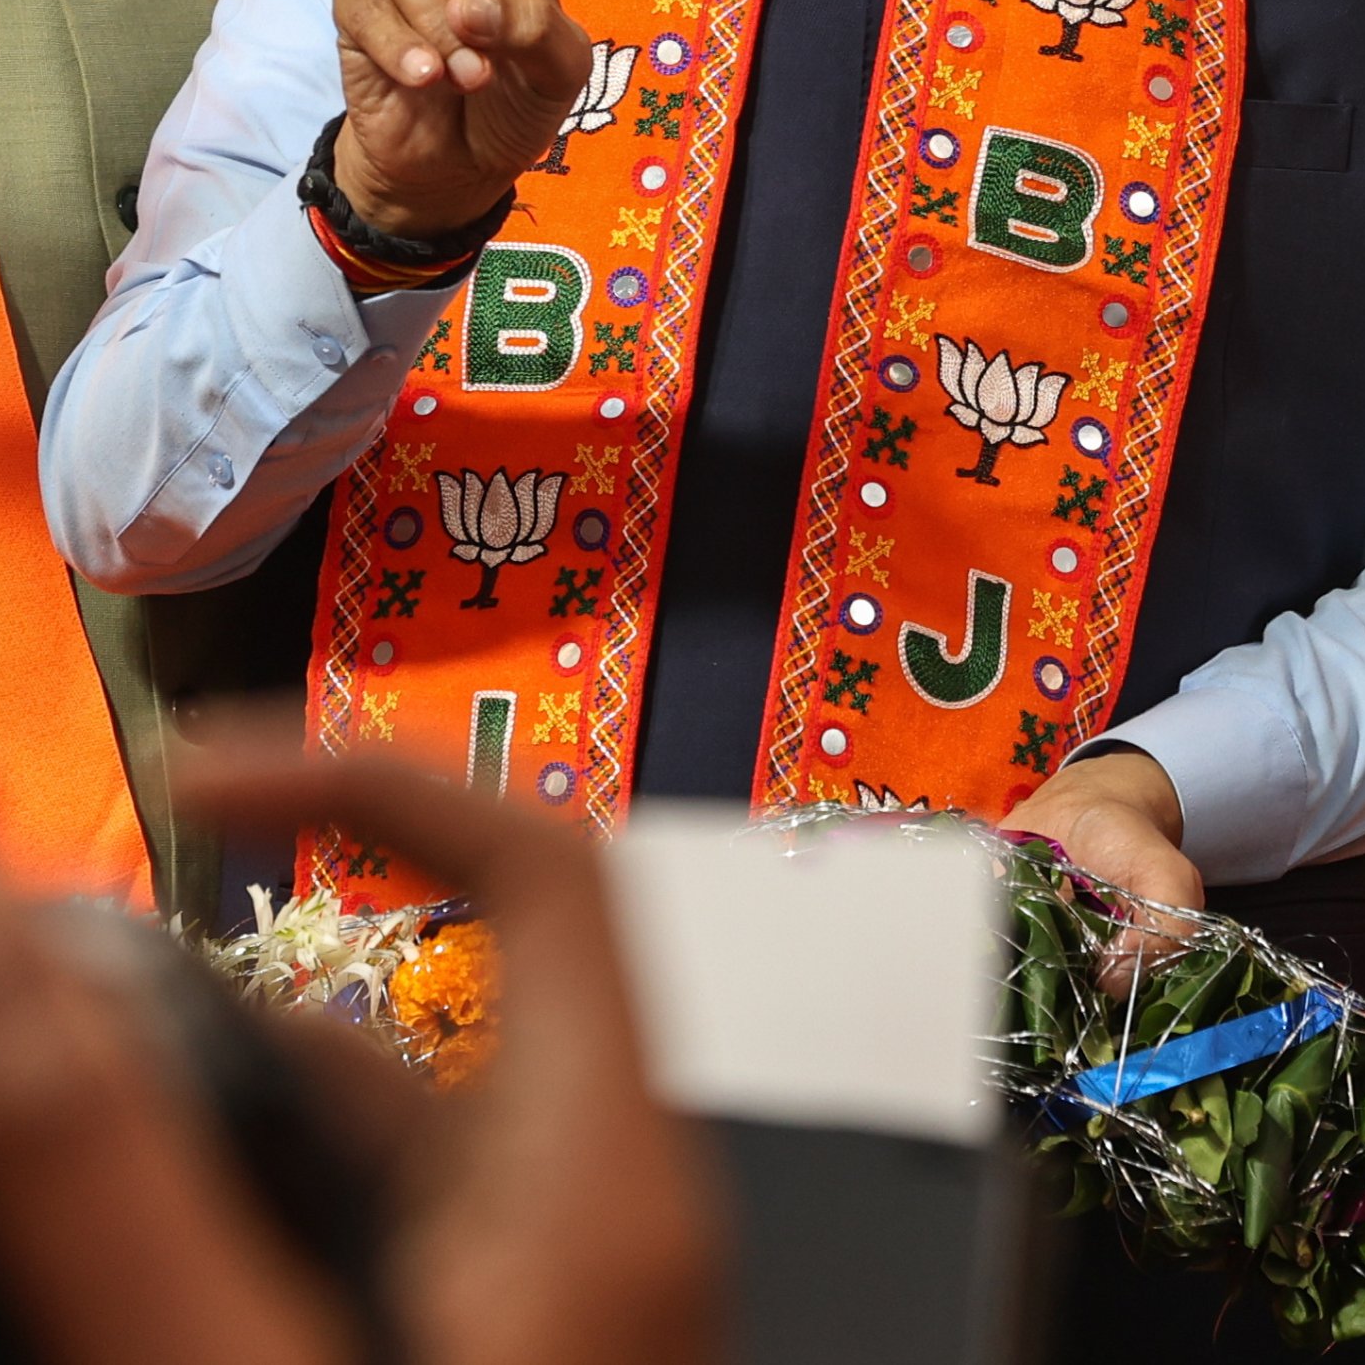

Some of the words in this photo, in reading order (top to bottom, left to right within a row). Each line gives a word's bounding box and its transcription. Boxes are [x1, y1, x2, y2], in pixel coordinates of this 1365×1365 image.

[968, 126, 1105, 274] B
[461, 242, 592, 392] B
[897, 569, 1013, 709] J
